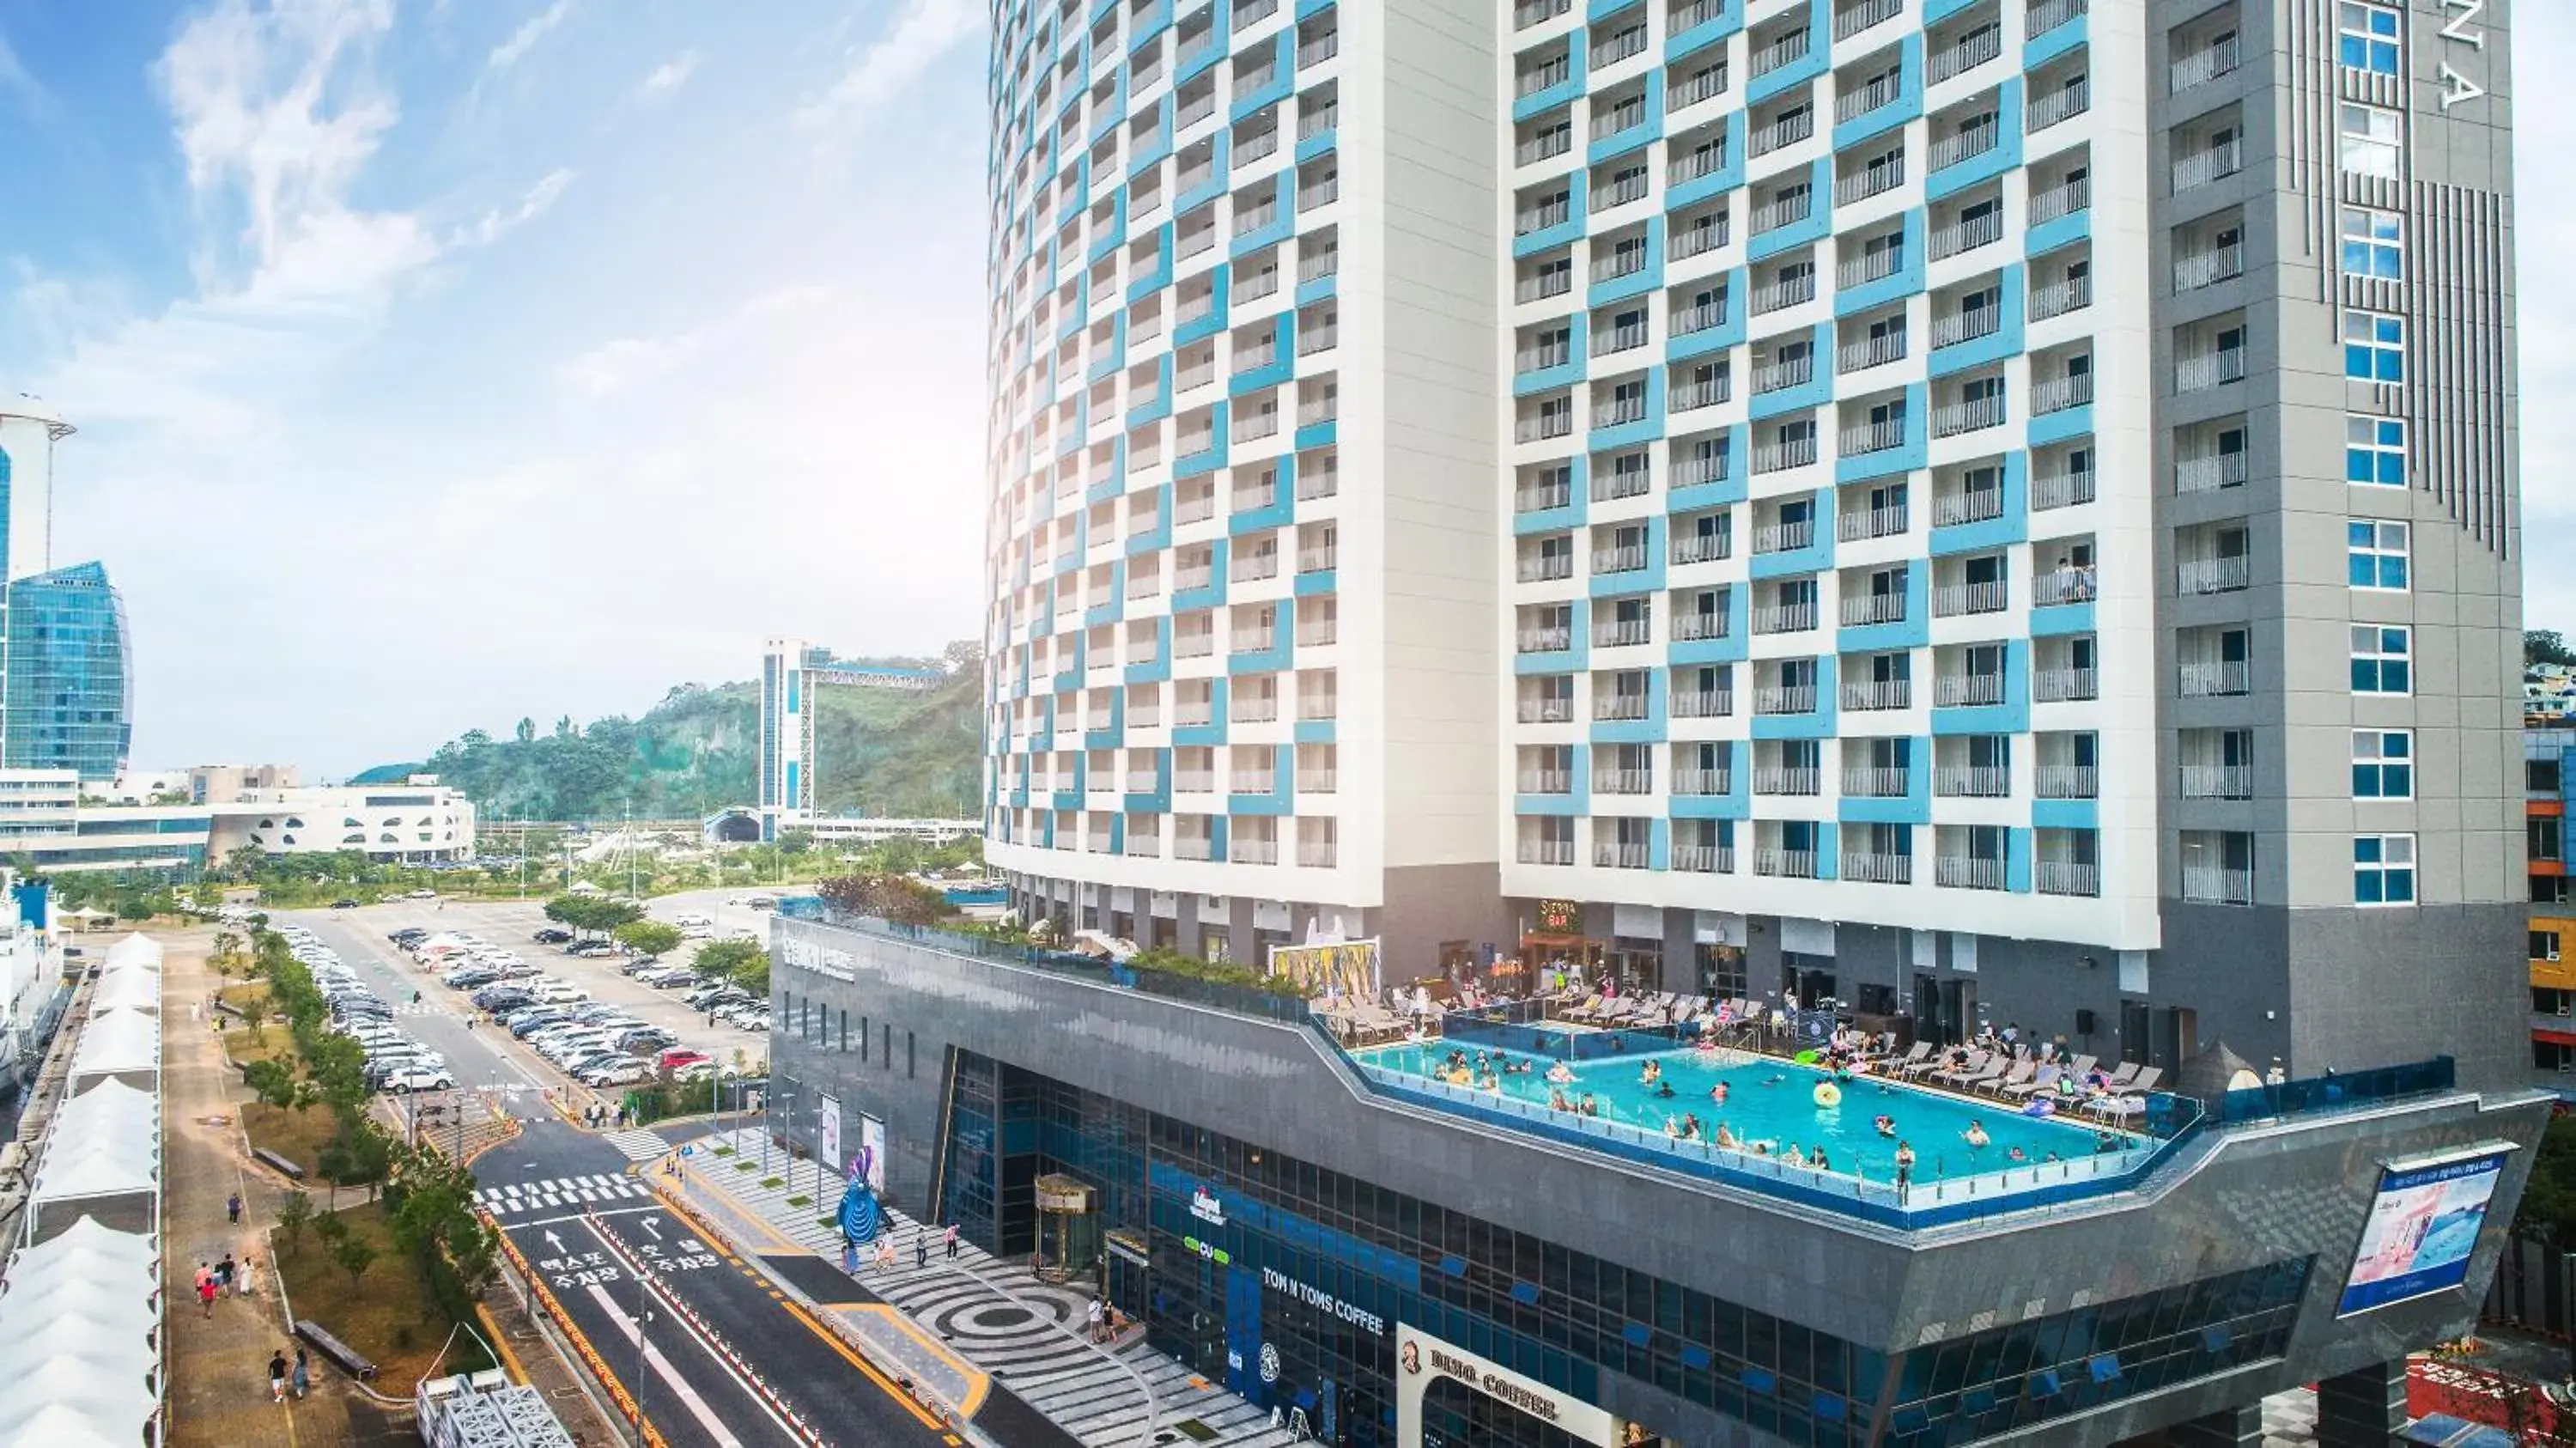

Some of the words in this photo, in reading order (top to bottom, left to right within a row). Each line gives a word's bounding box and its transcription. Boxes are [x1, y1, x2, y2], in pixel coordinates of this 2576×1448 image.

[1548, 915, 1568, 927] BAR
[1200, 1241, 1213, 1258] CU
[1298, 1282, 1334, 1313] TOMS
[1334, 1298, 1384, 1337] COFFEE
[1482, 1372, 1557, 1421] COFFEE
